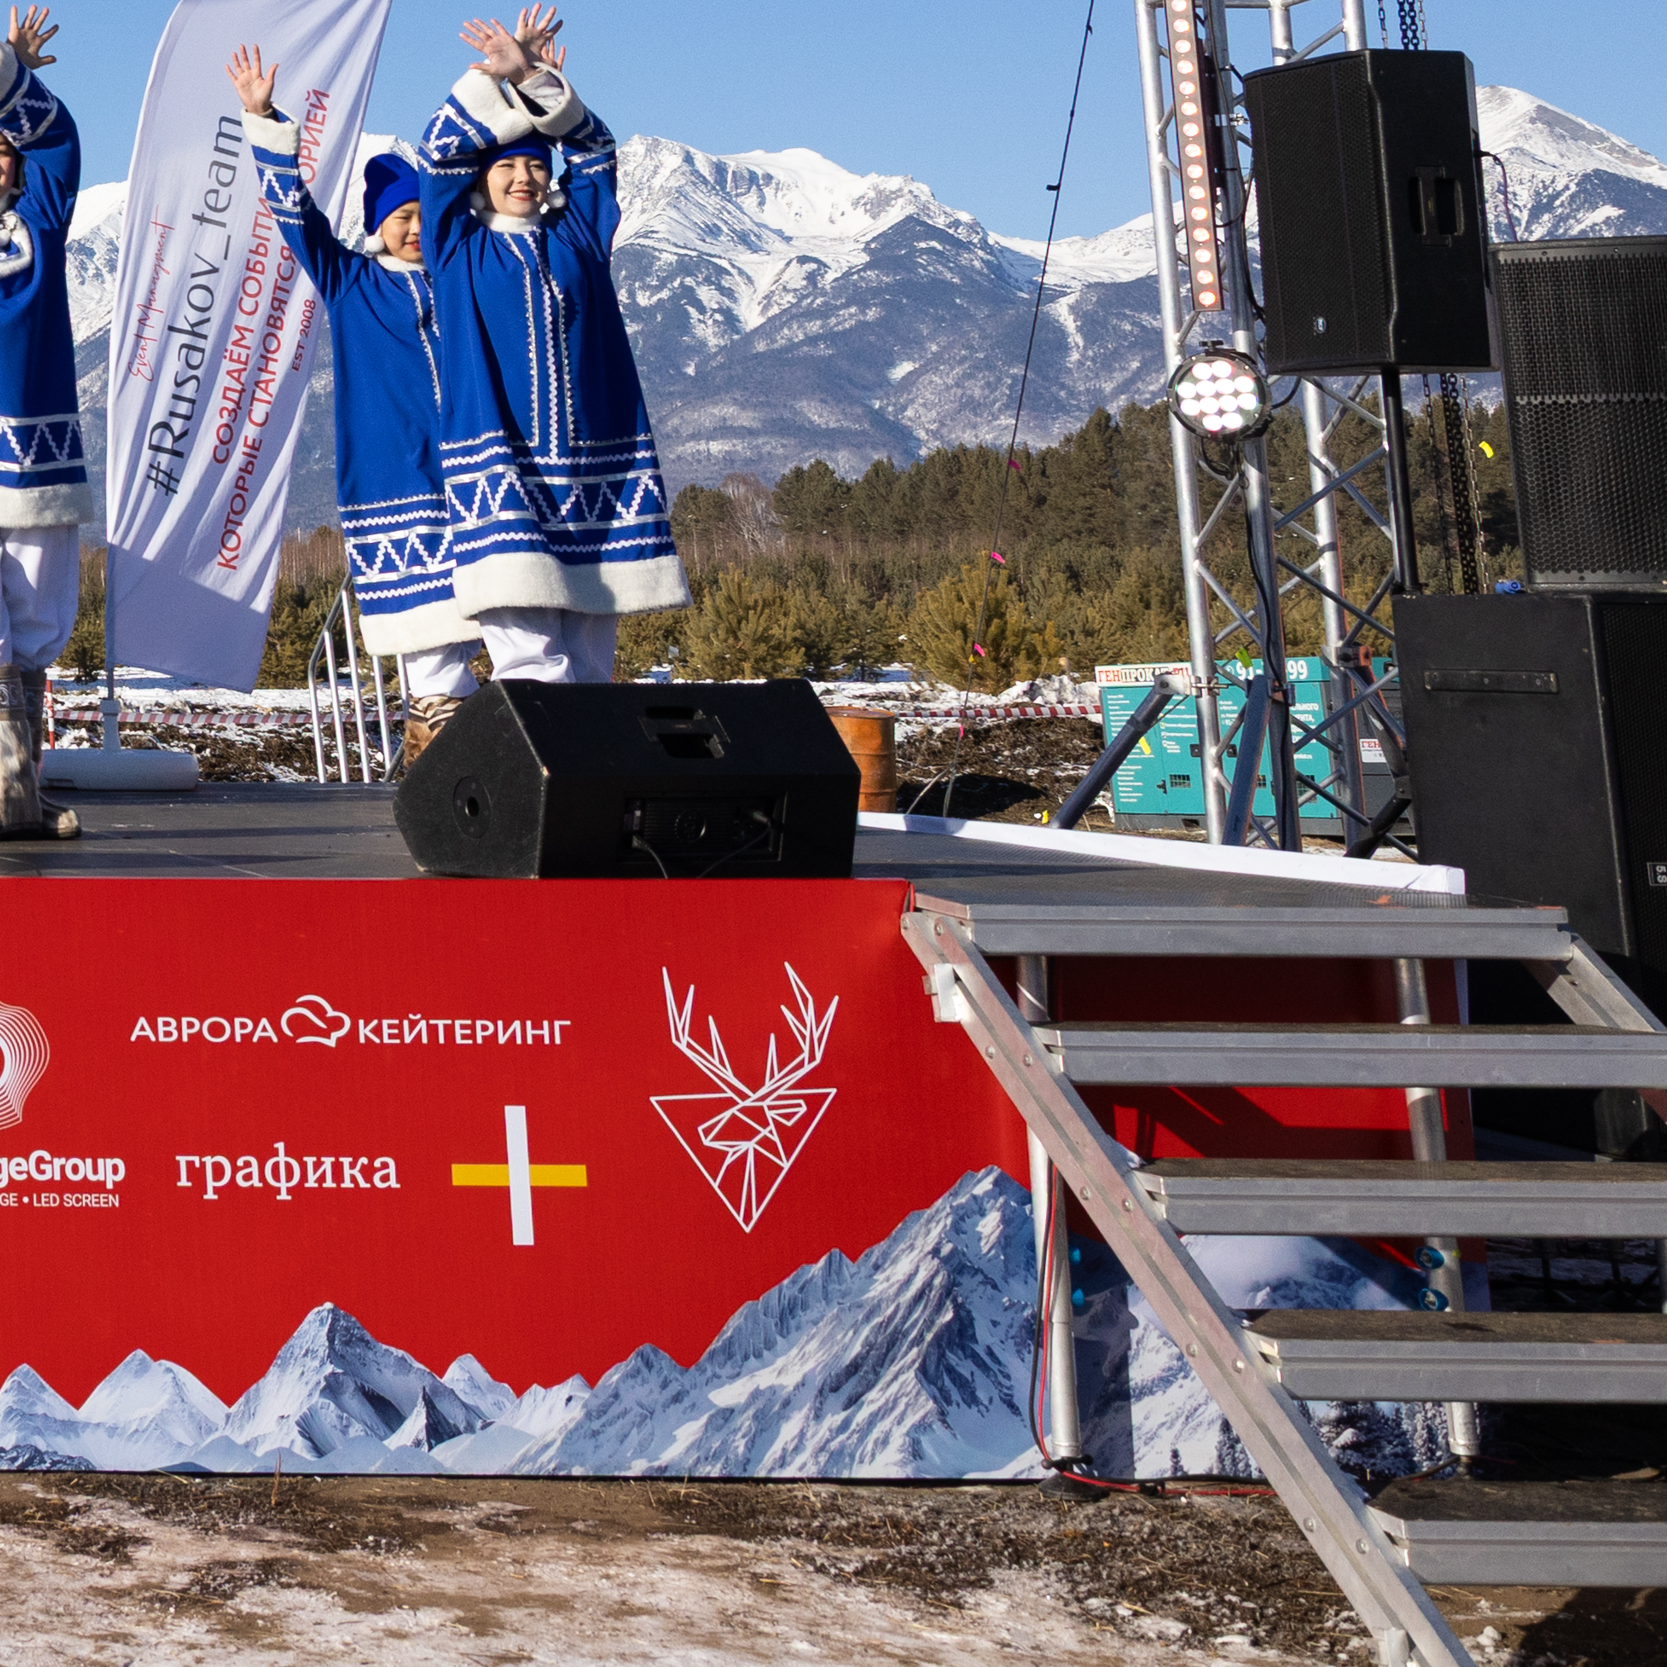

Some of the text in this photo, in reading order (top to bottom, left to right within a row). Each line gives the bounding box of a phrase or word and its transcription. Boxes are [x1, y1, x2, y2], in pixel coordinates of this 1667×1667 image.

[146, 115, 243, 496] #Rusakov_team
[213, 196, 275, 465] СОЗДАЁМ СОБЫТИ
[291, 298, 317, 372] EST 2008
[128, 324, 158, 383] Event
[218, 438, 263, 571] КОТОРЫЕ
[247, 245, 297, 429] СТАНОВЯТСЯ
[130, 1013, 571, 1045] АВРОРА КЕЙТЕРИНГ
[33, 1193, 60, 1207] LED
[63, 1193, 119, 1207] SCREEN
[175, 1141, 401, 1200] графика
